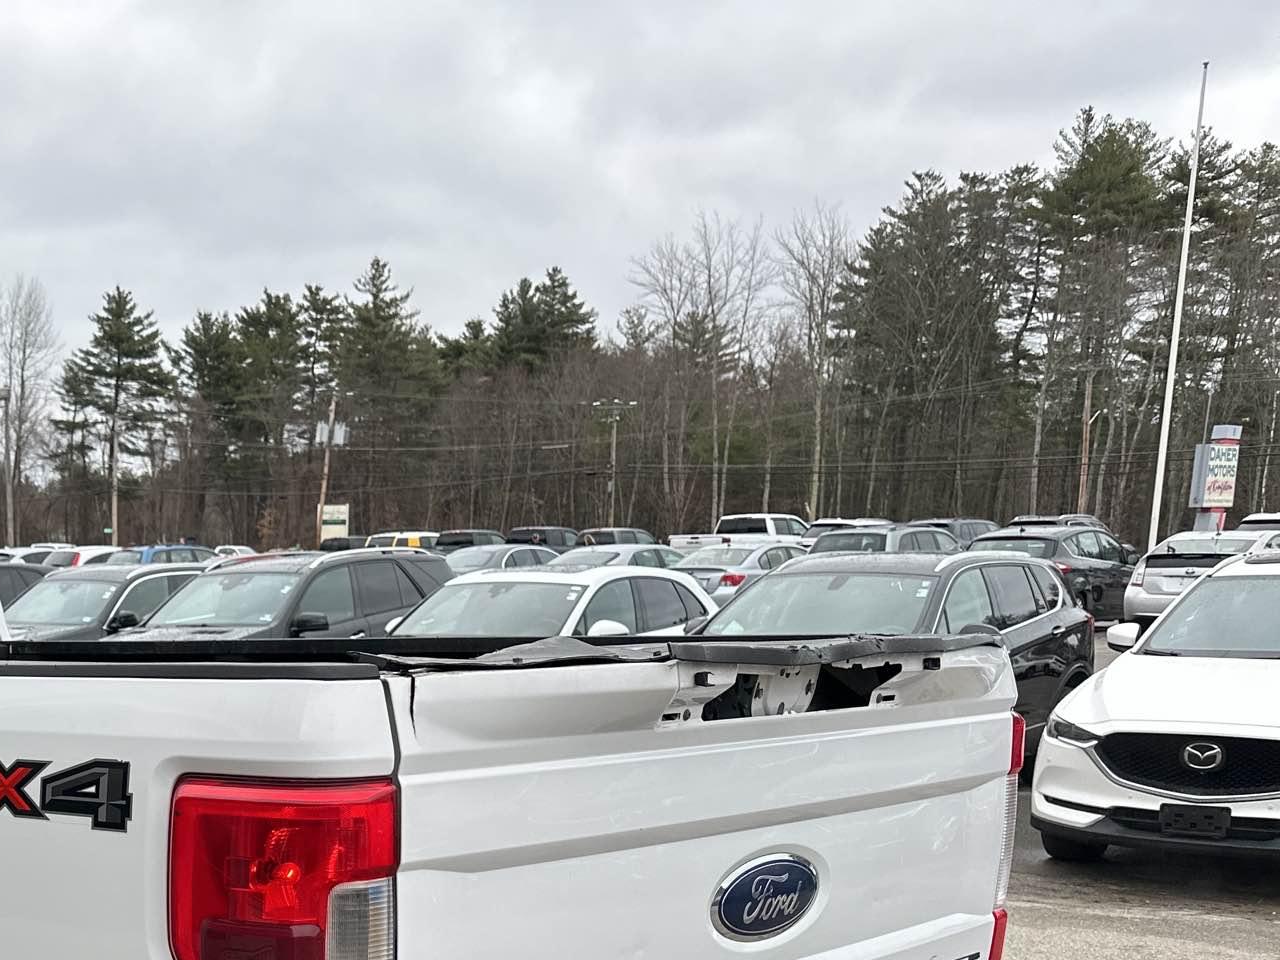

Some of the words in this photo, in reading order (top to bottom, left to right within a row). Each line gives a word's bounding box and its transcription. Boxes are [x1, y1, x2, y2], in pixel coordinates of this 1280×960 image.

[1208, 446, 1238, 462] DAHER
[1207, 464, 1236, 478] MOTORS
[742, 872, 805, 925] Ford
